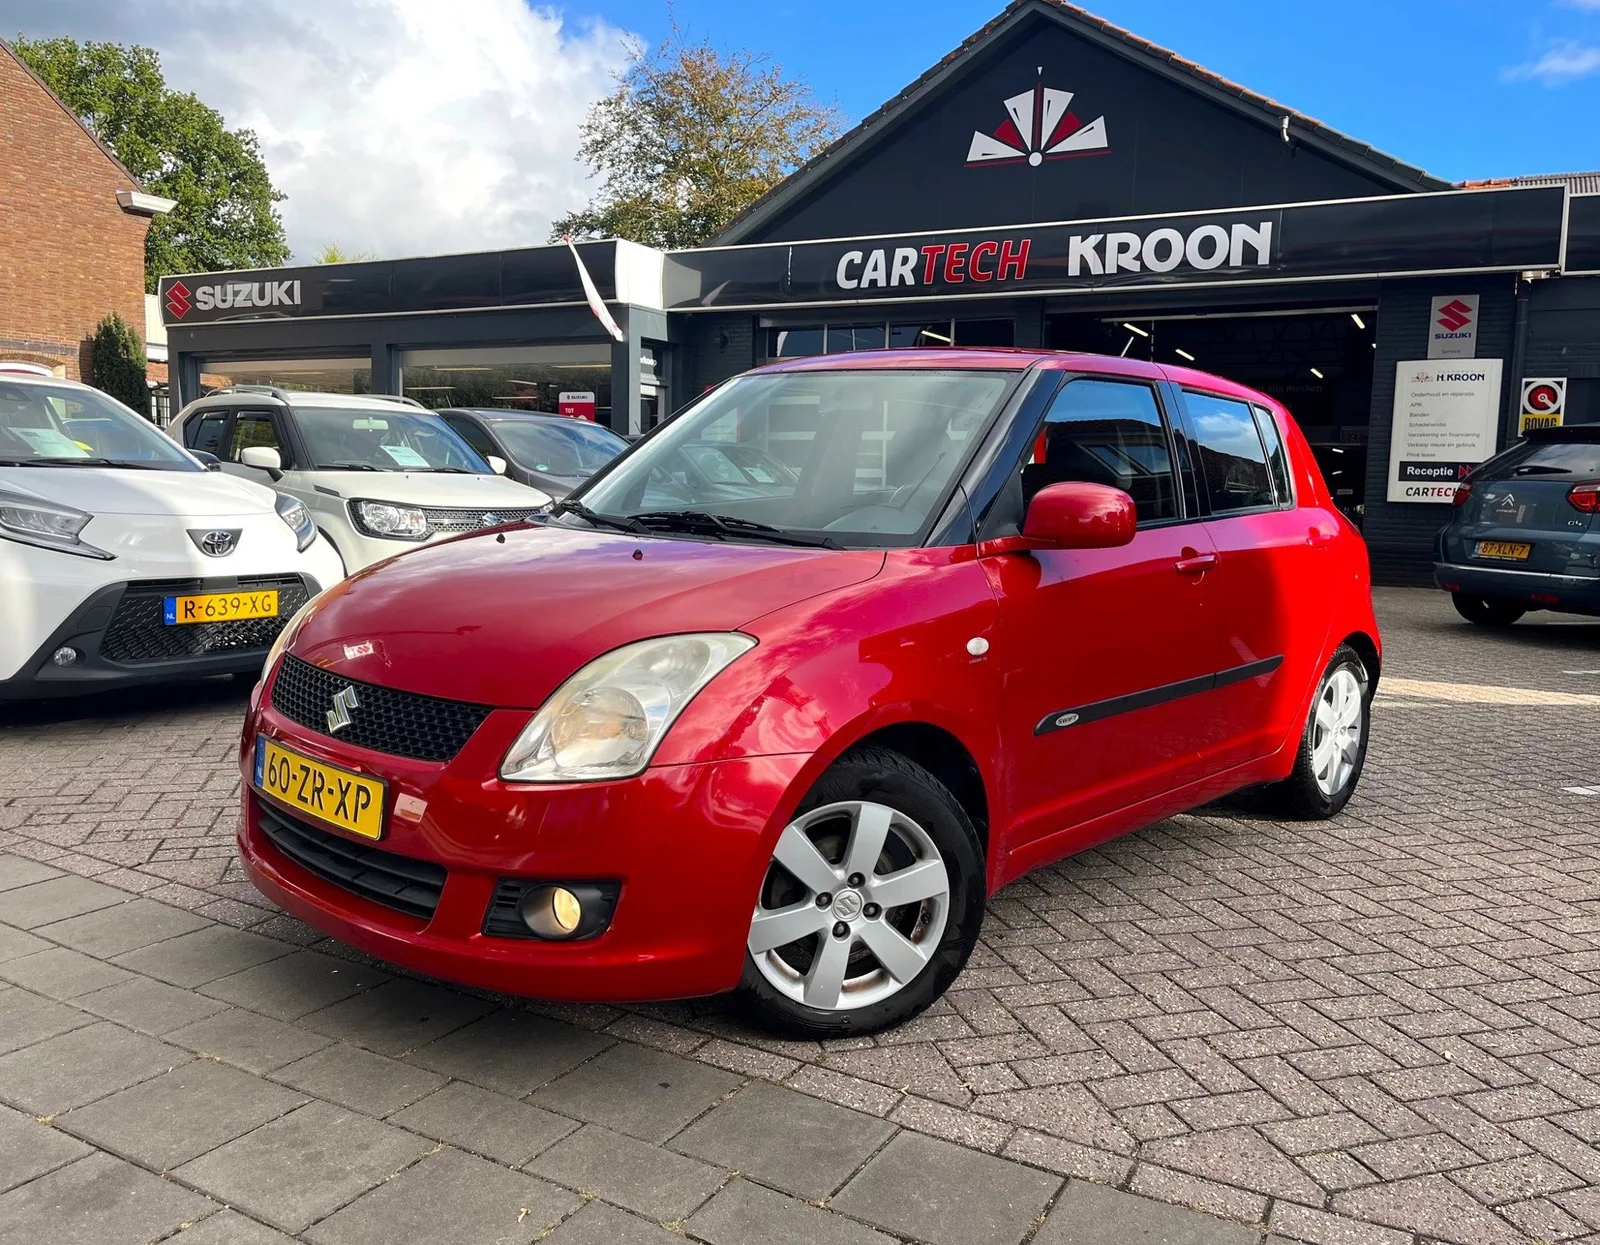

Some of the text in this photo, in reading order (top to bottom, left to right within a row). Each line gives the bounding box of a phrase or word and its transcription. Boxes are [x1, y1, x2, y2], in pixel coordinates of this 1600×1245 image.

[835, 221, 1273, 289] CARTECH KROON
[195, 280, 302, 311] SUZUKI
[1434, 332, 1472, 340] SUZUKI
[1406, 466, 1454, 478] Receptie
[1481, 542, 1527, 556] 87-XLN-7
[184, 594, 272, 619] R-639-XG
[1057, 714, 1078, 726] SWIFT
[268, 752, 371, 823] 60-ZR-XP
